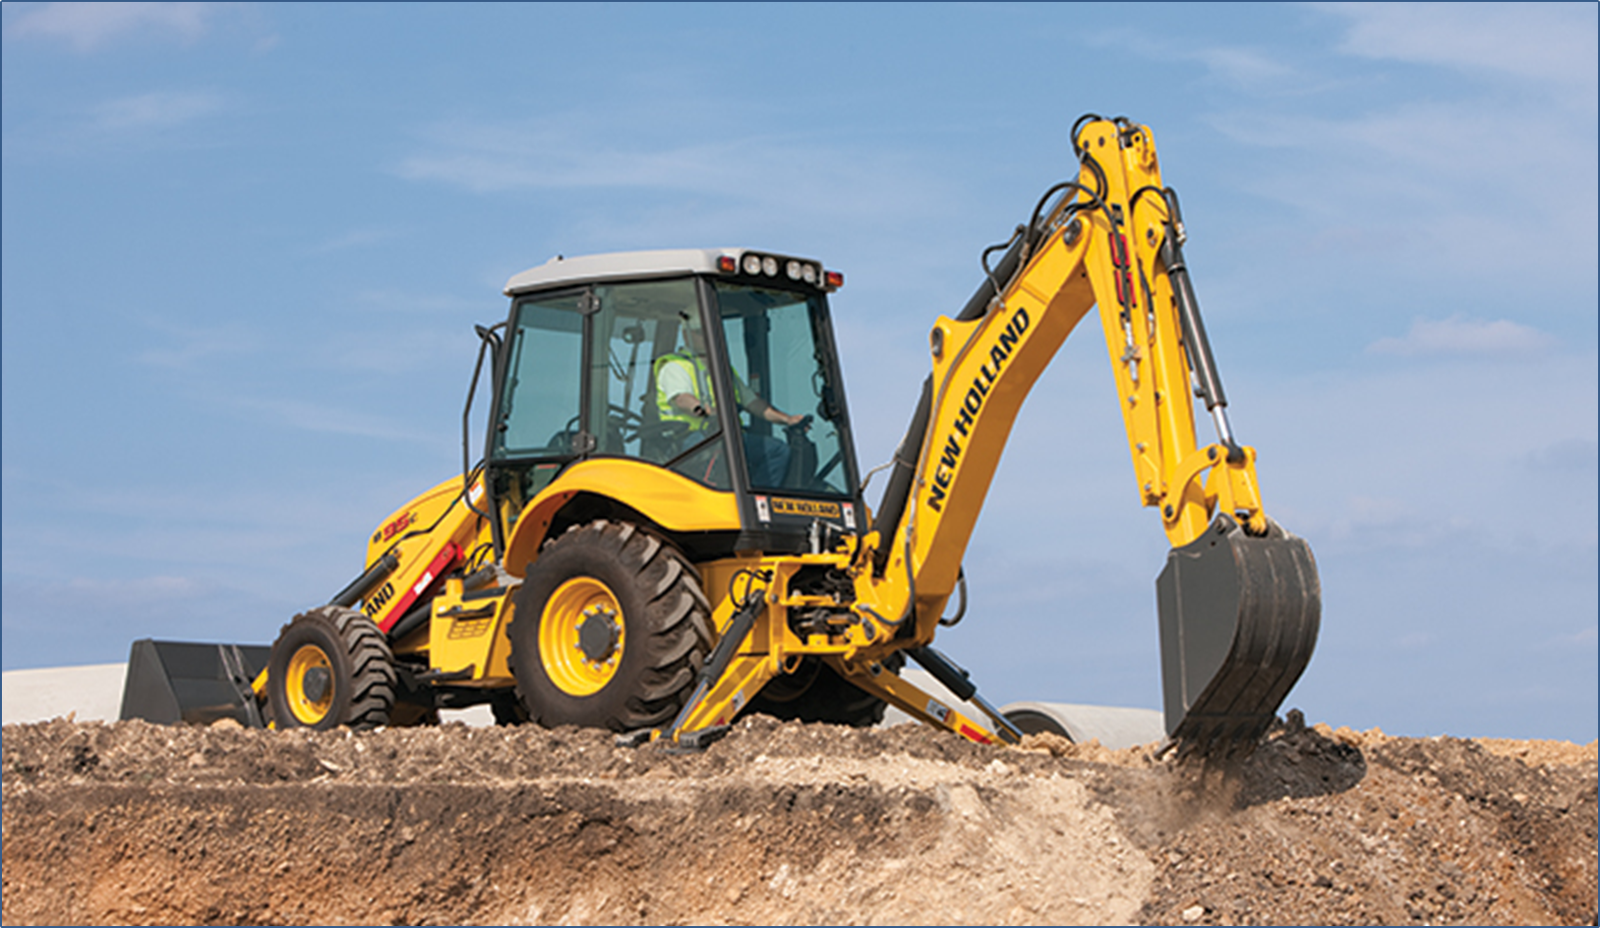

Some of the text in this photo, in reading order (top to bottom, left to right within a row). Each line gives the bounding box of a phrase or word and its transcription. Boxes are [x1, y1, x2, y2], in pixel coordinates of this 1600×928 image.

[927, 307, 1030, 513] NEW HOLLAND
[774, 500, 838, 515] NEW HOLLAND
